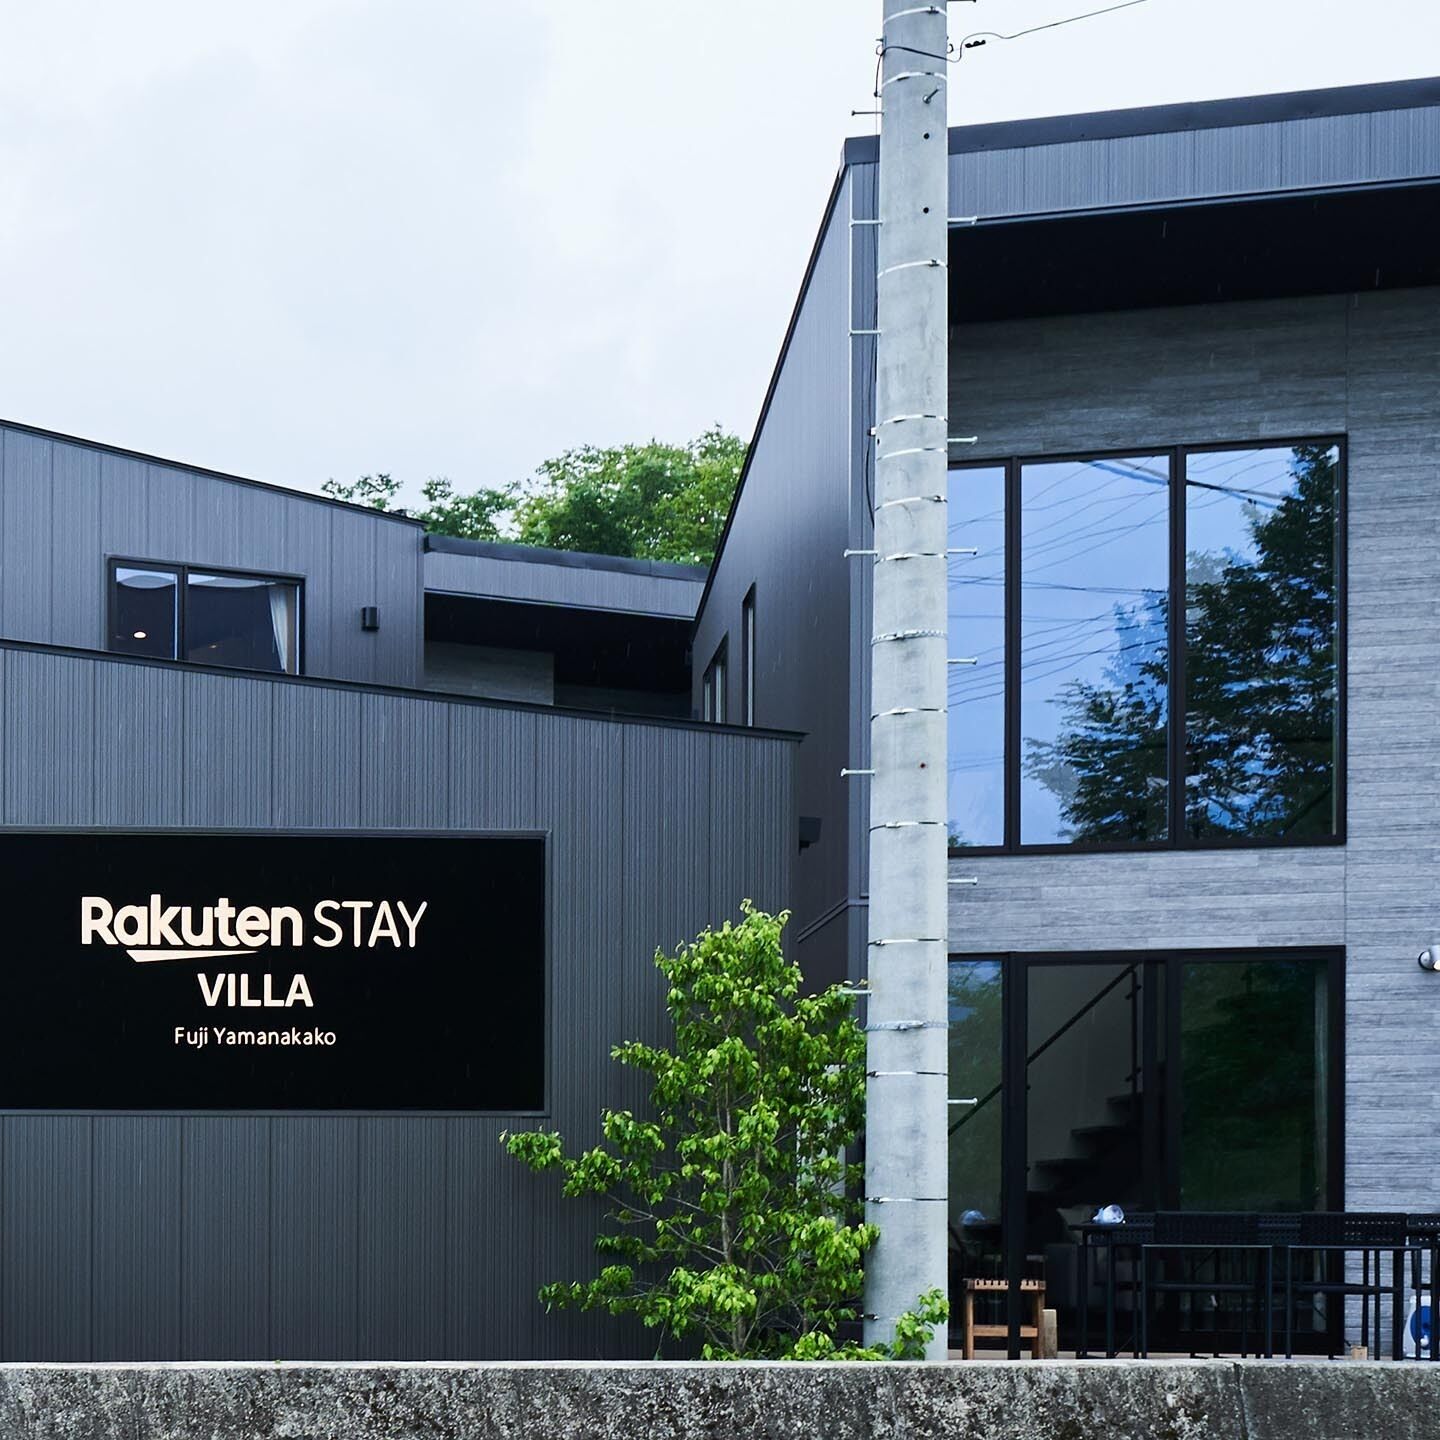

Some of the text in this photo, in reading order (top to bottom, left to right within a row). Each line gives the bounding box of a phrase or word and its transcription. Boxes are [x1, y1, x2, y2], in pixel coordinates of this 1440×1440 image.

[81, 893, 428, 948] Rakuten STAY
[197, 972, 314, 1008] VILLA
[174, 1026, 337, 1049] Fuji Yamanakako
